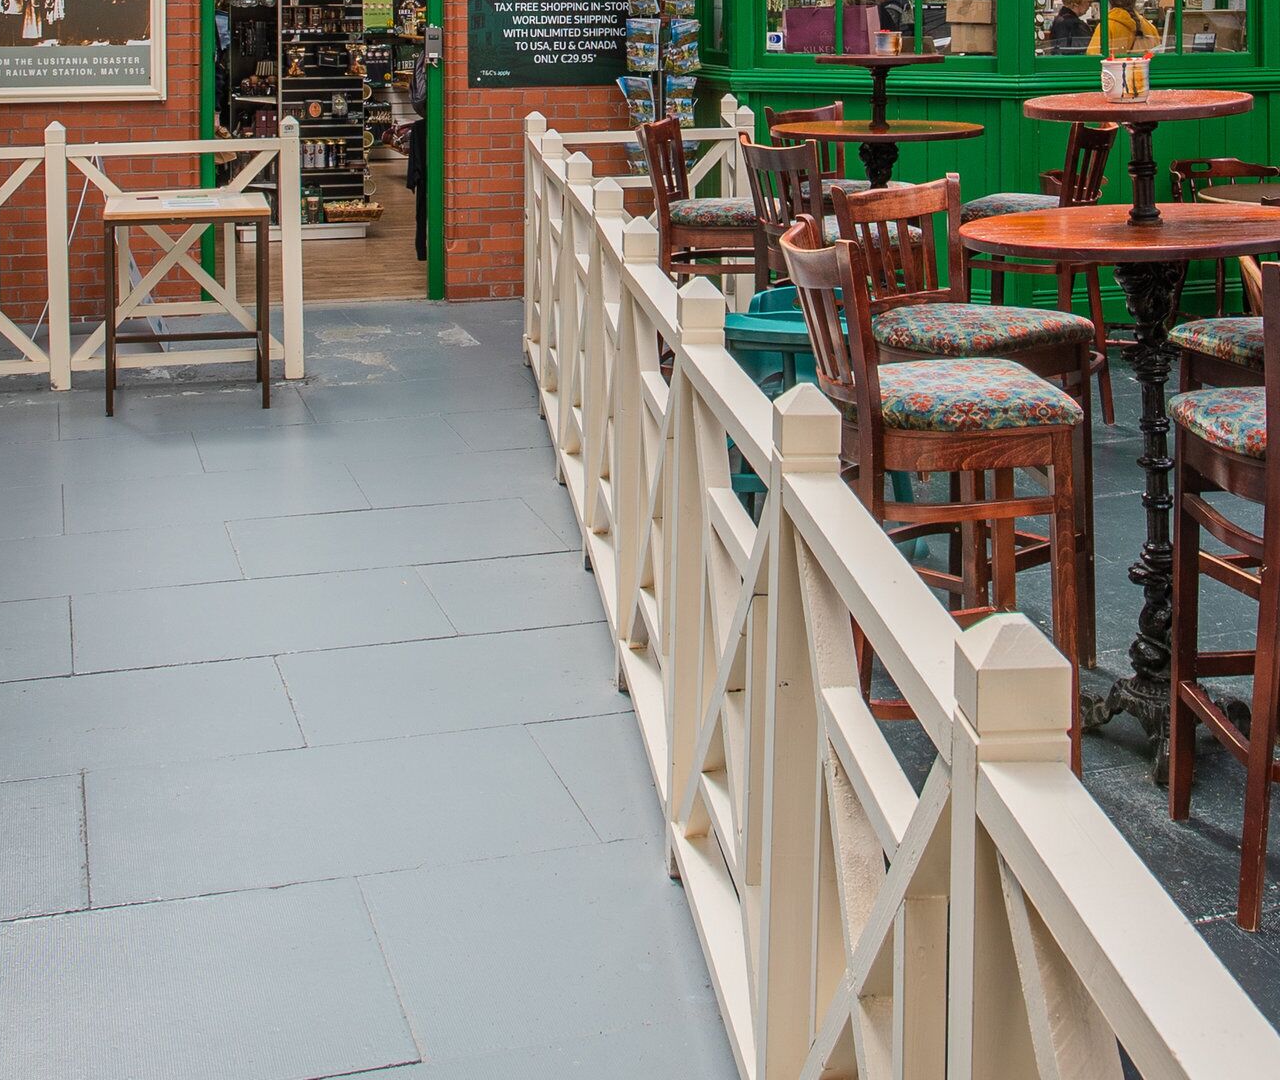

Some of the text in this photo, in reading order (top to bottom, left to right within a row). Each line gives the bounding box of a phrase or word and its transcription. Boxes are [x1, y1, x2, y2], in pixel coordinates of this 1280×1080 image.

[494, 1, 629, 12] TAX FREE SHOPPING IN-STOR
[512, 15, 618, 25] WORLDWIDE SHIPPING
[503, 27, 626, 38] WITH UNLIMITED SHIPPING
[515, 41, 528, 51] TO
[553, 41, 567, 50] EU
[568, 41, 576, 50] &
[577, 41, 617, 50] CANADA
[803, 45, 851, 53] KILKENY
[15, 58, 33, 66] THE
[37, 57, 88, 65] LUSITANIA
[93, 56, 140, 64] DISASTER
[533, 54, 559, 64] ONLY
[6, 68, 48, 77] RAILWAY
[124, 67, 145, 75] 1915
